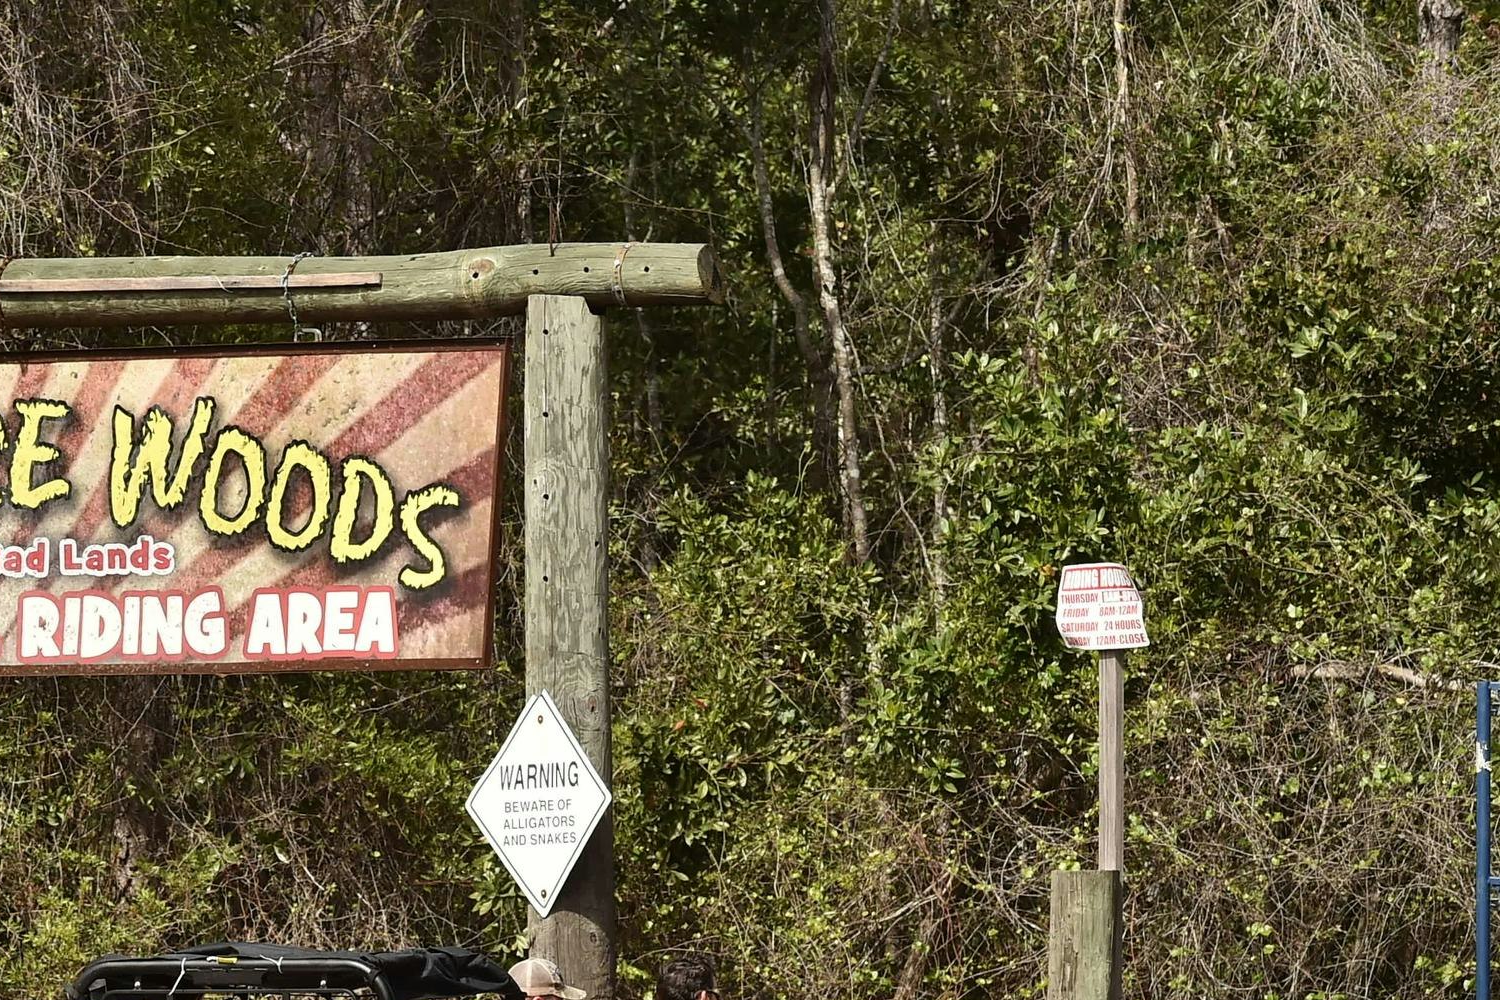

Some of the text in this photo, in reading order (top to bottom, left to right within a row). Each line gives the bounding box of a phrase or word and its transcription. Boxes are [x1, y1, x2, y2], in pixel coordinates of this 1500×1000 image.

[109, 396, 460, 591] WOODS
[60, 537, 174, 575] Lands
[1061, 593, 1099, 605] THURSDAY
[1063, 608, 1089, 618] FRIDAY
[21, 590, 228, 658] RIDING
[244, 589, 397, 656] AREA
[1060, 619, 1142, 633] SATURDAY 24 HOURS
[500, 761, 579, 791] WARNING
[504, 799, 572, 813] BEWARE OF
[503, 815, 575, 830] ALLIGATORS
[503, 832, 577, 847] AND SNAKES
